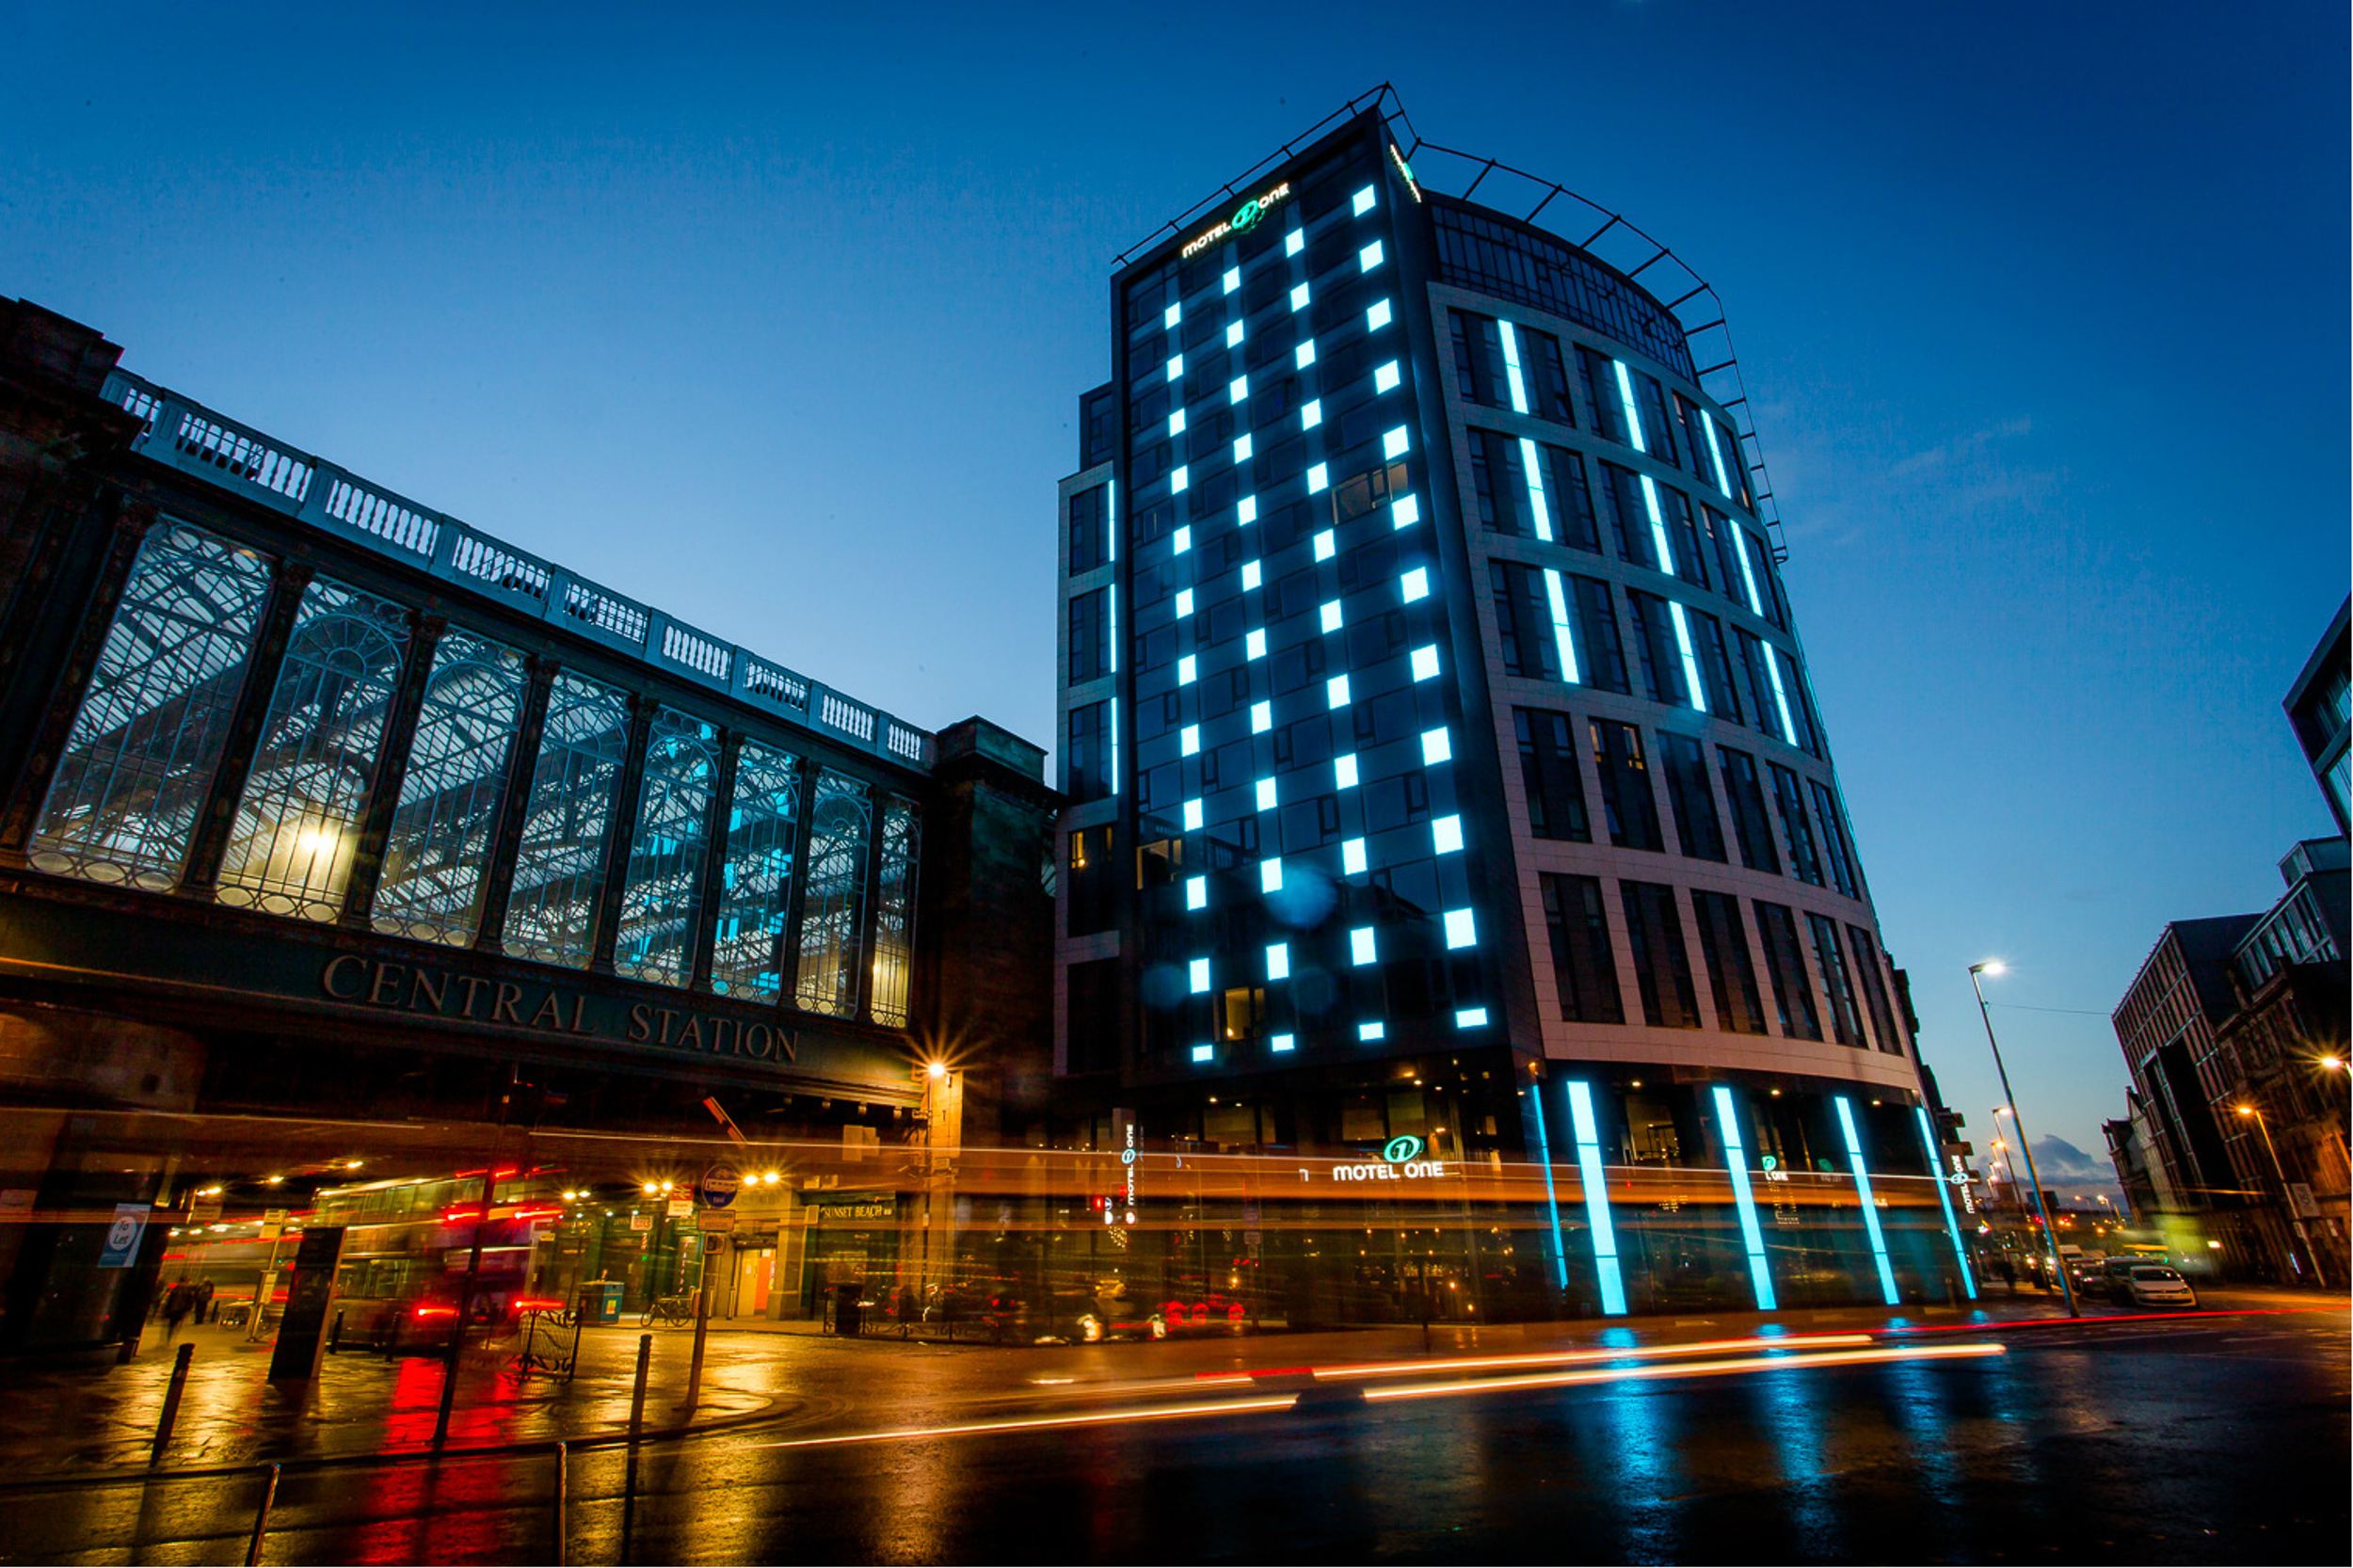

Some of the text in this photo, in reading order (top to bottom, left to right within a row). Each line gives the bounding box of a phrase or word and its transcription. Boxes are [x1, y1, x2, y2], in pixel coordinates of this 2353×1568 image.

[1181, 221, 1232, 259] MOTEL
[1257, 183, 1289, 209] ONE
[321, 953, 800, 1063] CENTRAL STATION
[1127, 1163, 1135, 1206] MOTEL
[1333, 1161, 1445, 1181] MOTEL ONE
